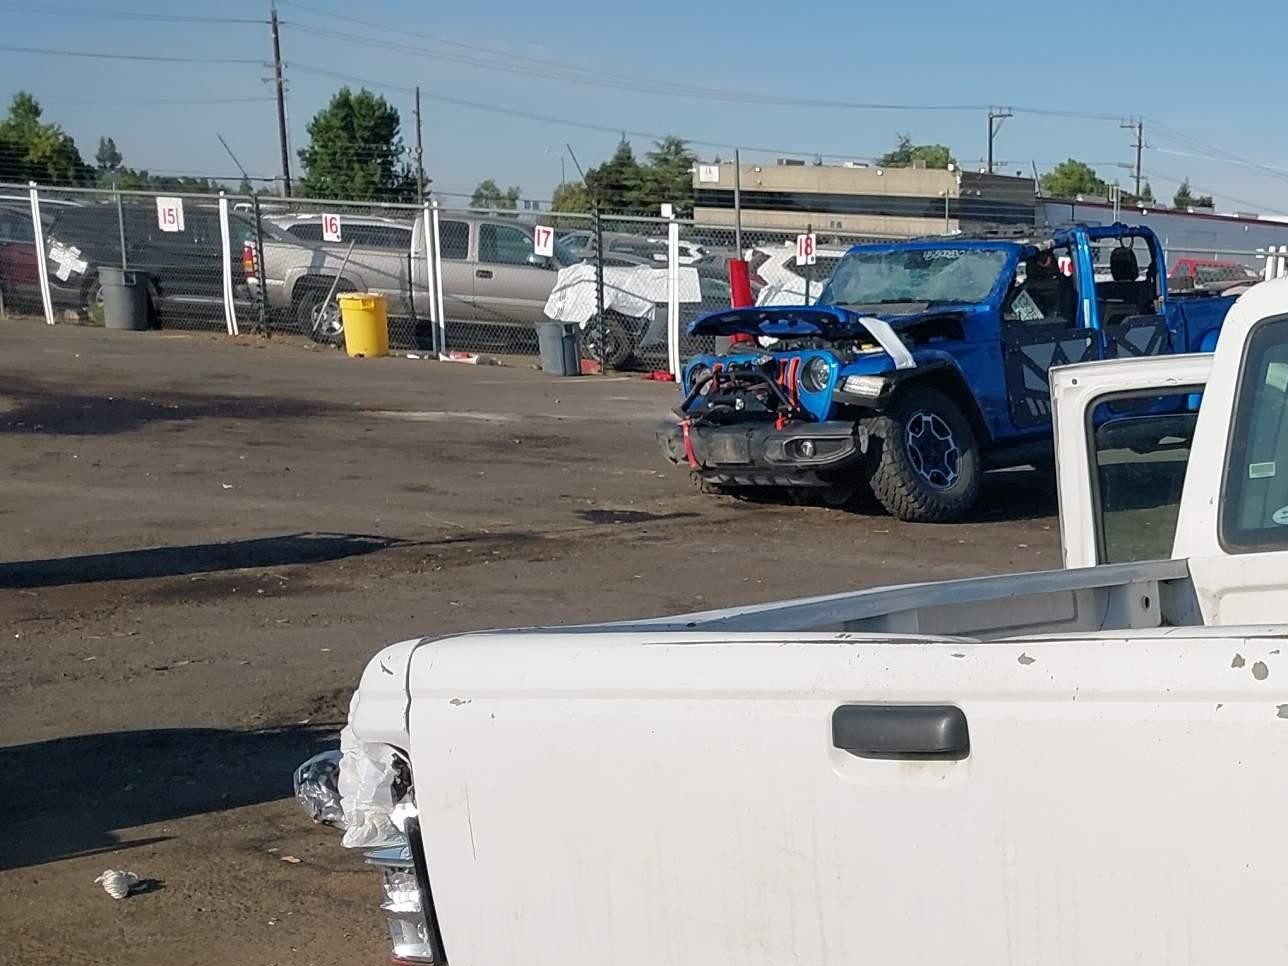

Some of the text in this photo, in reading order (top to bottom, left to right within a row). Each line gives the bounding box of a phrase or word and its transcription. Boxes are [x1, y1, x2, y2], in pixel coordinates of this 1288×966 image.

[163, 207, 176, 225] 15
[325, 215, 338, 234] 16
[537, 229, 551, 248] 17
[800, 236, 813, 256] 18
